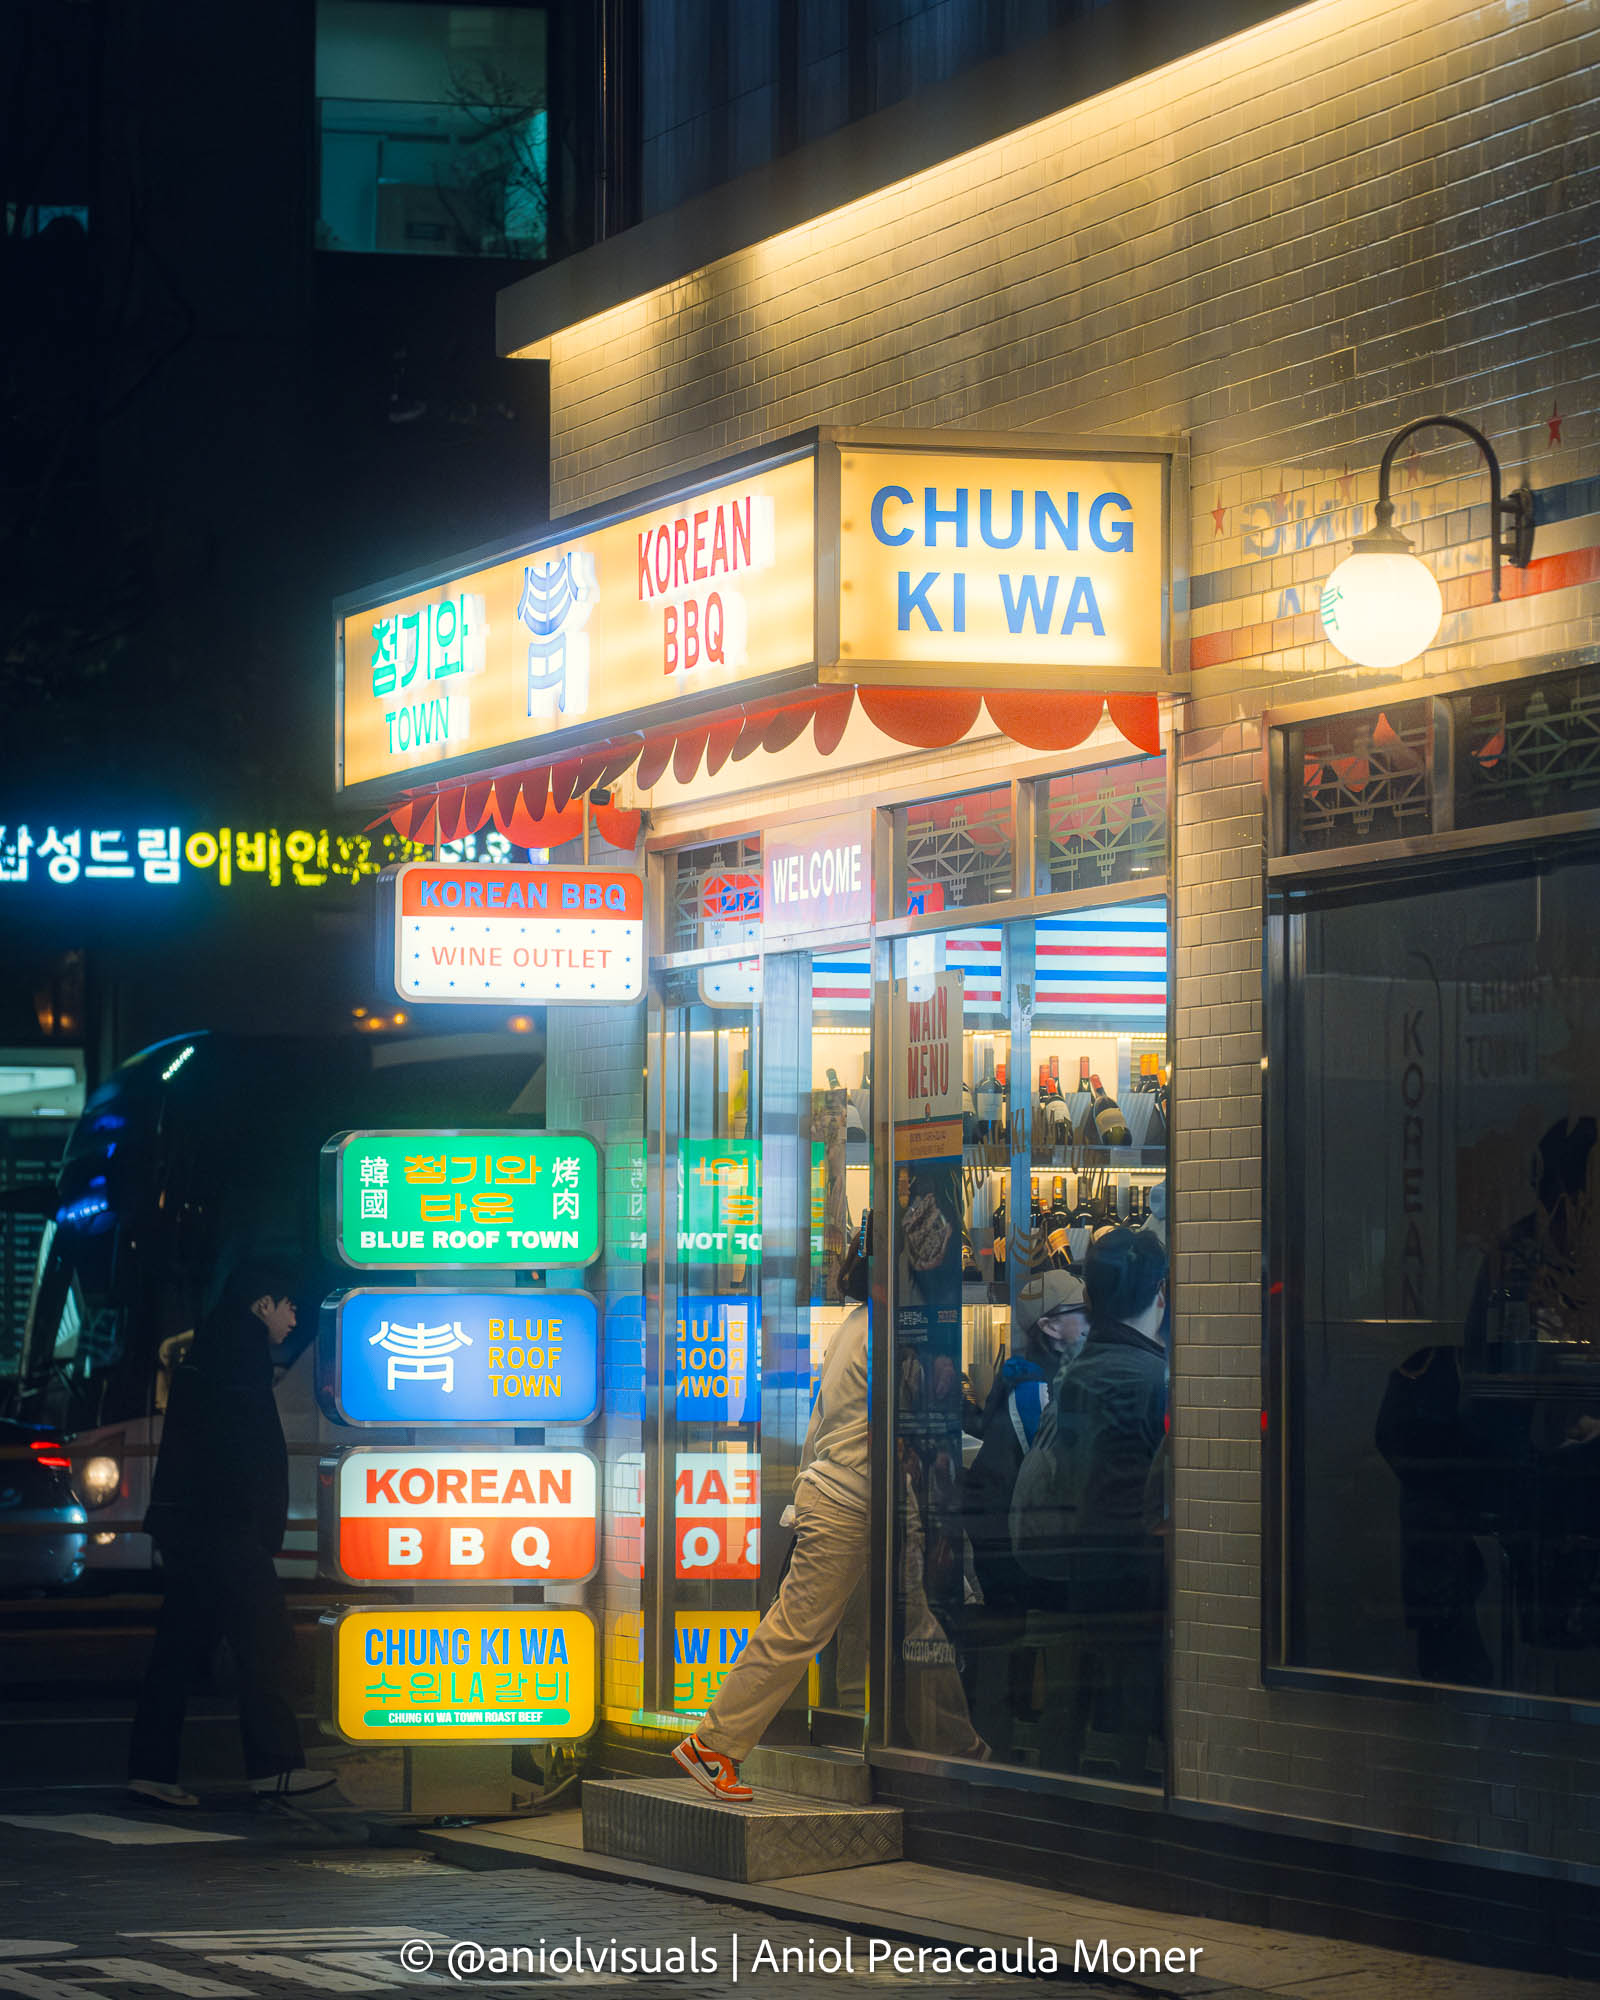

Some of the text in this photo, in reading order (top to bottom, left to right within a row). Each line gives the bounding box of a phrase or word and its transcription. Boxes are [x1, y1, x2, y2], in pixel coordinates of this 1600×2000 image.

[870, 485, 1134, 553] CHUNG
[638, 496, 751, 600] KOREAN
[898, 571, 1106, 636] KI WA
[372, 594, 468, 697] 청기와
[664, 591, 725, 675] BBQ
[386, 697, 449, 753] TOWN
[772, 845, 861, 904] WELCOME
[421, 880, 627, 912] KOREAN BBQ
[432, 946, 613, 969] WINE OUTLET
[910, 985, 948, 1043] MAIN
[908, 1043, 949, 1099] MENU
[360, 1156, 389, 1219] 韓國
[404, 1155, 542, 1184] 청기와
[552, 1157, 580, 1219] 烤肉
[421, 1193, 514, 1223] 타운
[360, 1231, 579, 1248] BLUE ROOF TOWN
[488, 1319, 563, 1341] BLUE
[488, 1347, 561, 1369] ROOF
[488, 1375, 561, 1397] TOWN
[366, 1468, 571, 1505] KOREAN
[388, 1527, 551, 1569] BBQ
[365, 1628, 568, 1666] CHUNG KI WA
[388, 1712, 543, 1723] CHUNG KI WA TOWN ROAST BEEF
